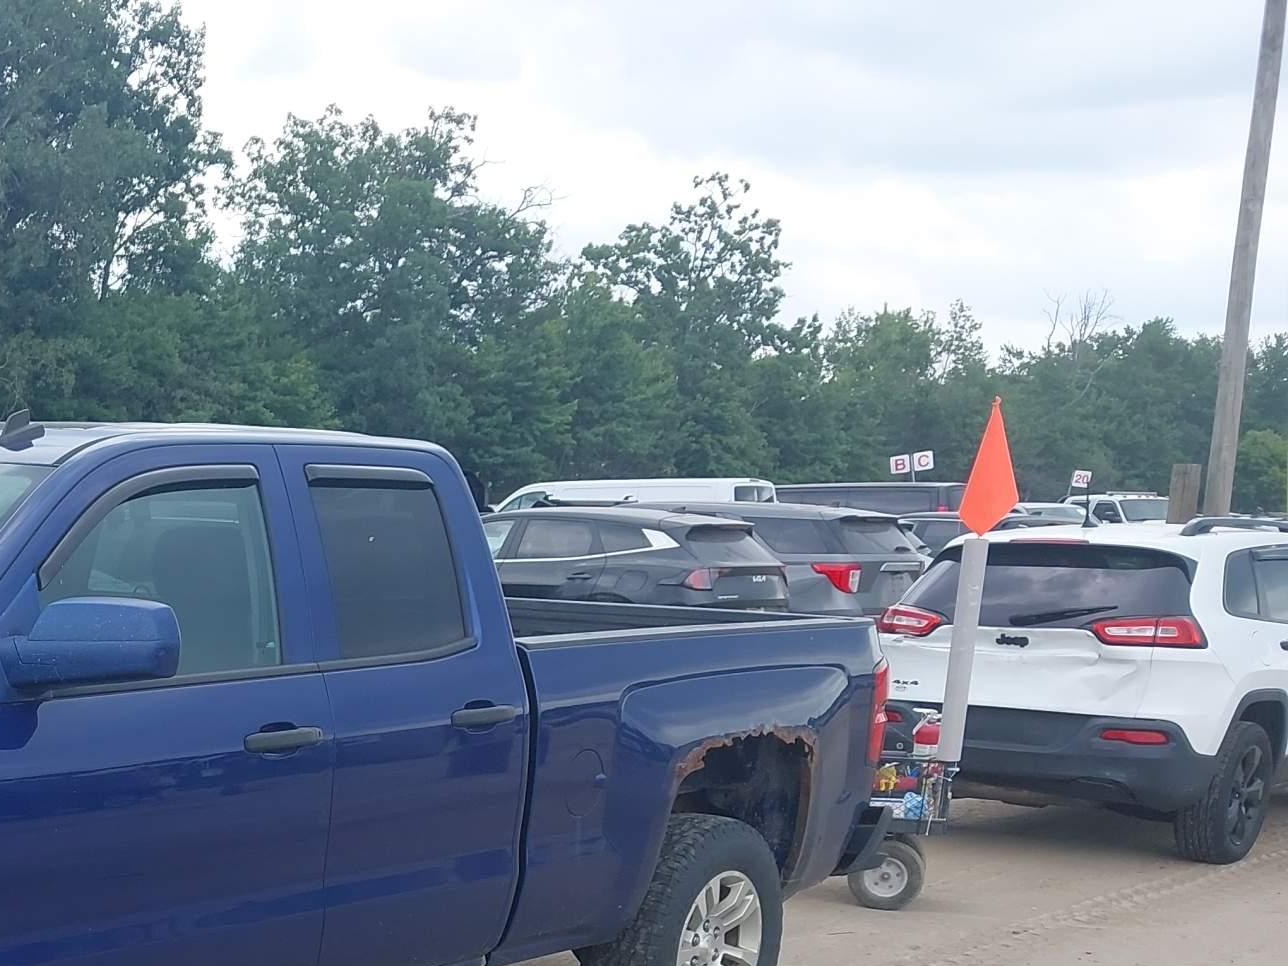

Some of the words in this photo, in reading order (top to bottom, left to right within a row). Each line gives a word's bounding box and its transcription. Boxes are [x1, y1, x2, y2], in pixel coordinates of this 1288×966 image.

[894, 459, 906, 471] B
[917, 454, 929, 467] C
[1074, 474, 1089, 484] 20
[995, 633, 1029, 648] Jeep
